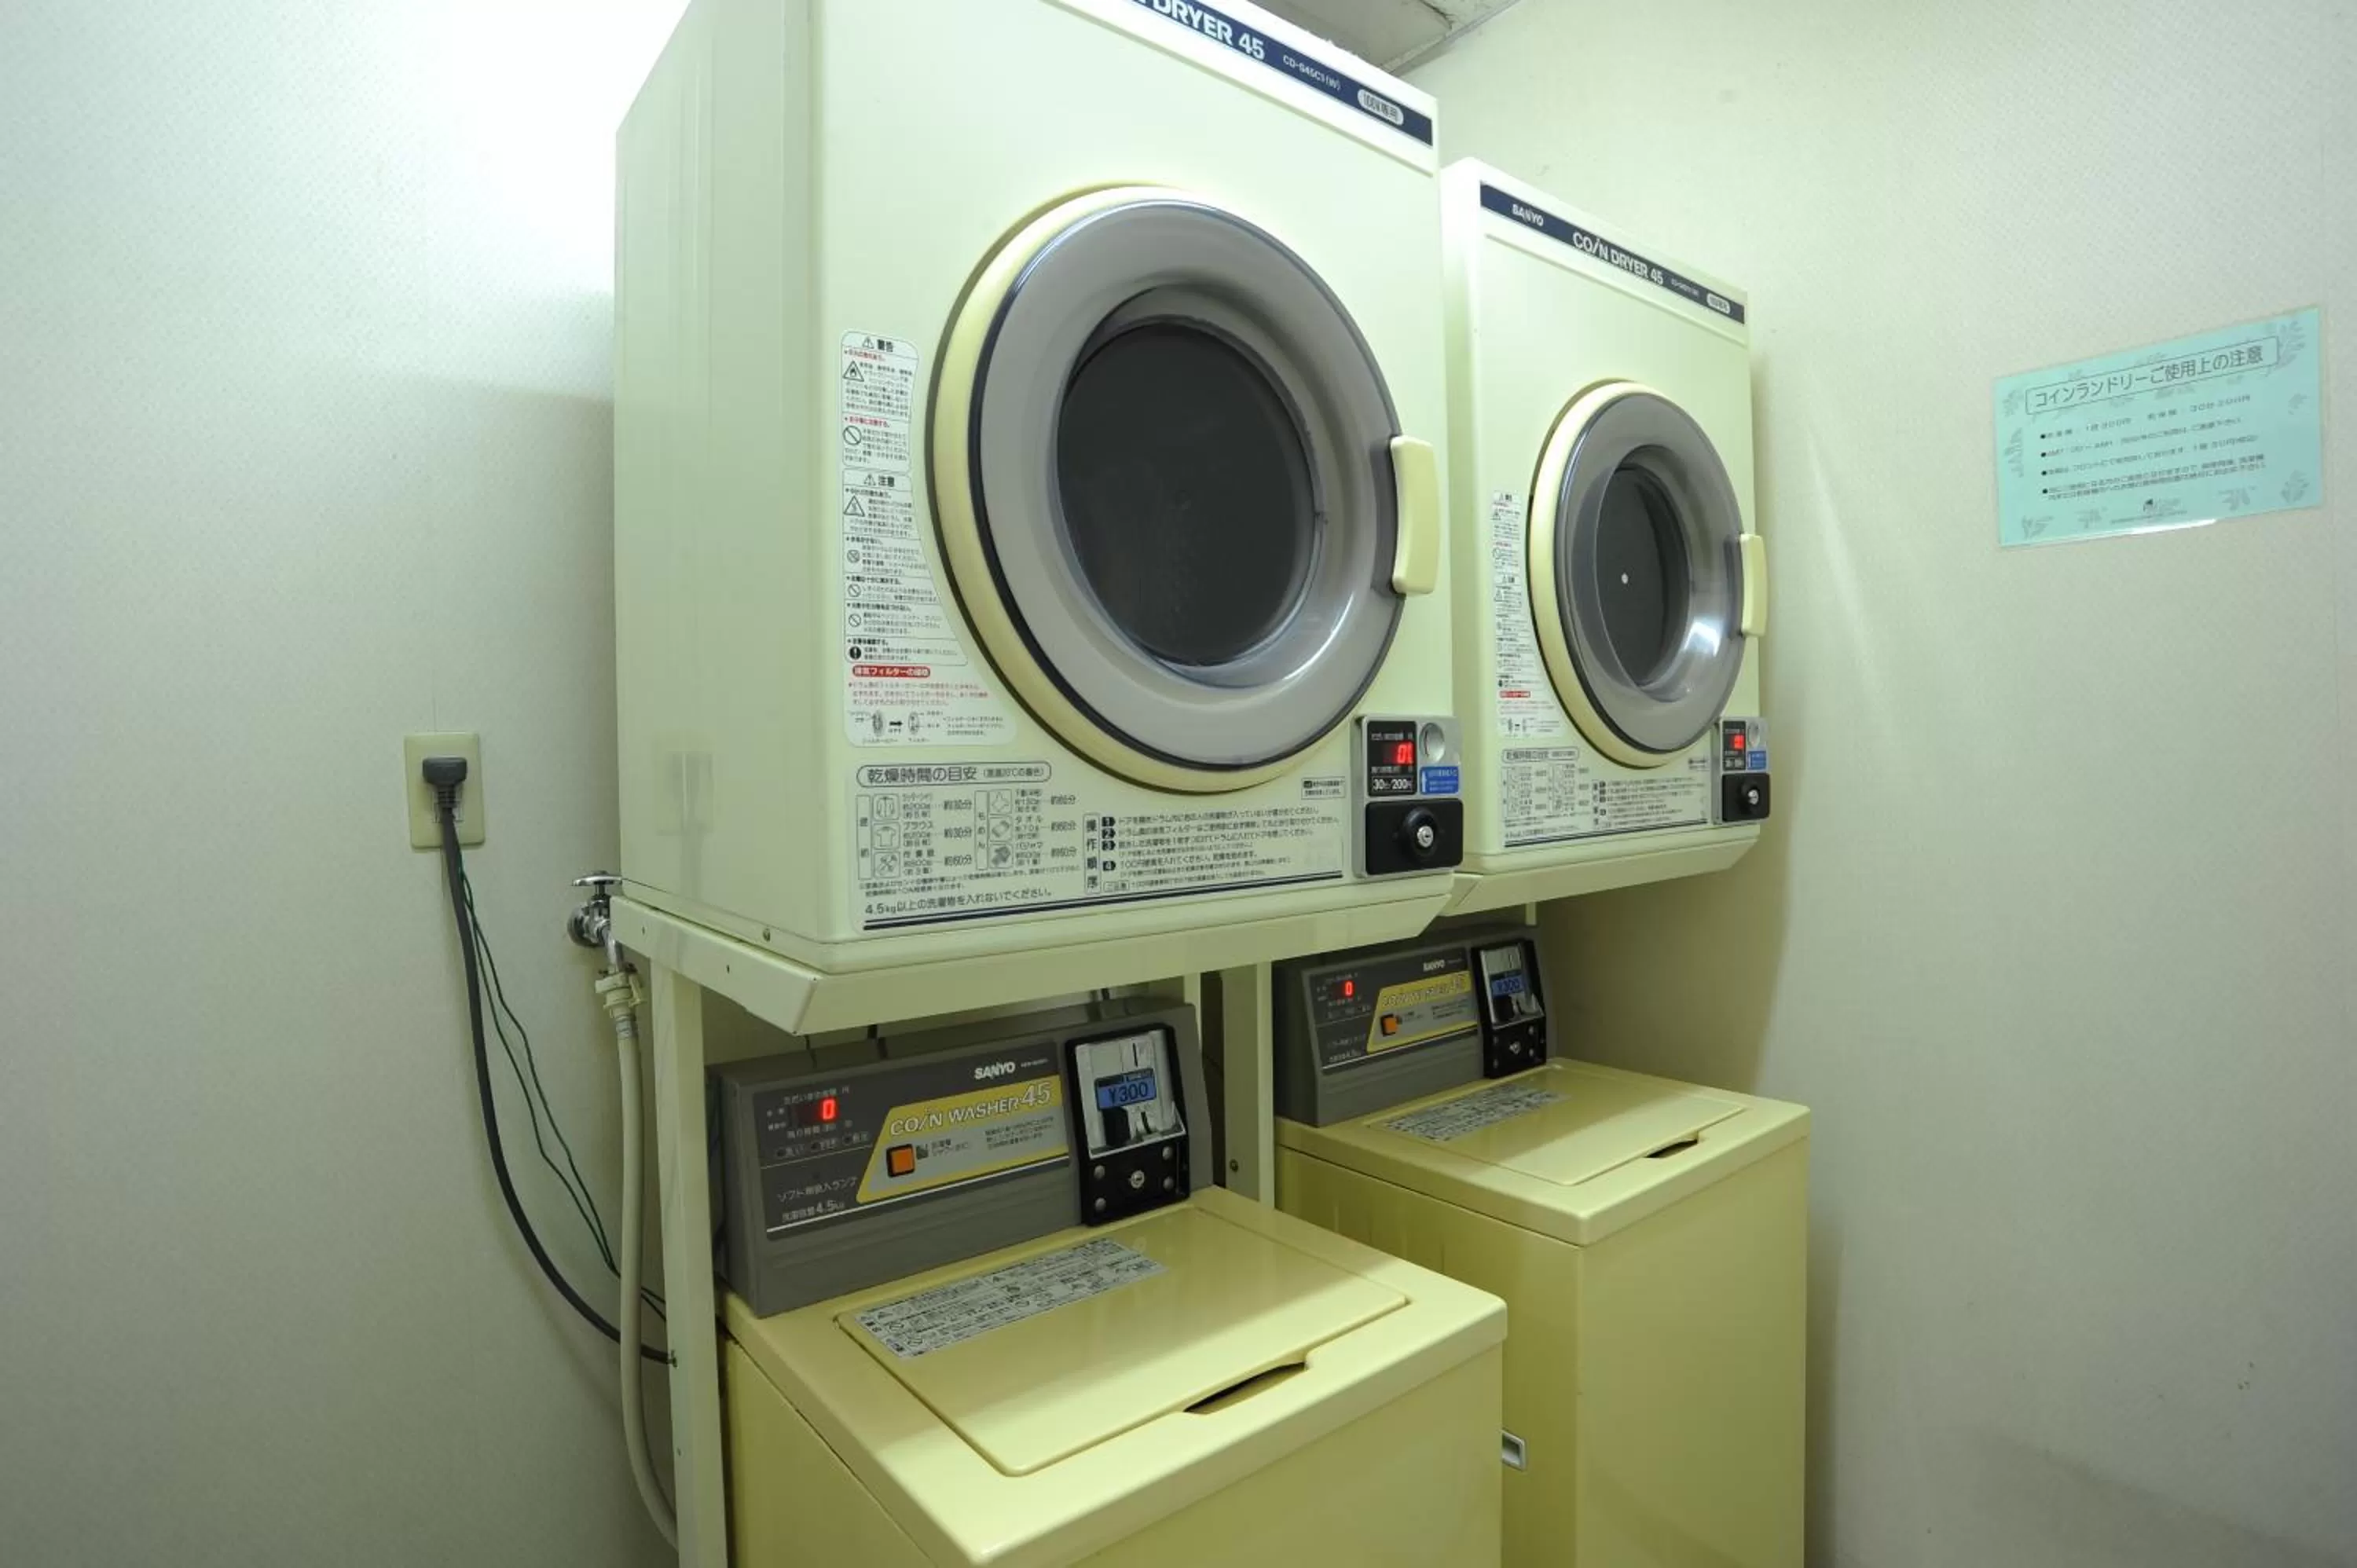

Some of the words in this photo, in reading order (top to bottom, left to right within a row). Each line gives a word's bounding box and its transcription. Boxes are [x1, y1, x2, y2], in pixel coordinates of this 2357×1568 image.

[1152, 0, 1233, 46] DRYER
[1238, 32, 1265, 60] 45
[1512, 203, 1544, 226] SANYO
[1611, 248, 1649, 279] DRYER
[1651, 268, 1664, 285] 45
[2035, 344, 2264, 408] コインランドリーご使用上の注意
[867, 767, 977, 784] 乾燥時間の目安
[974, 1061, 1016, 1080] SANYO
[823, 1098, 836, 1121] 0
[948, 1097, 1020, 1124] WASHER
[1019, 1081, 1051, 1107] 45
